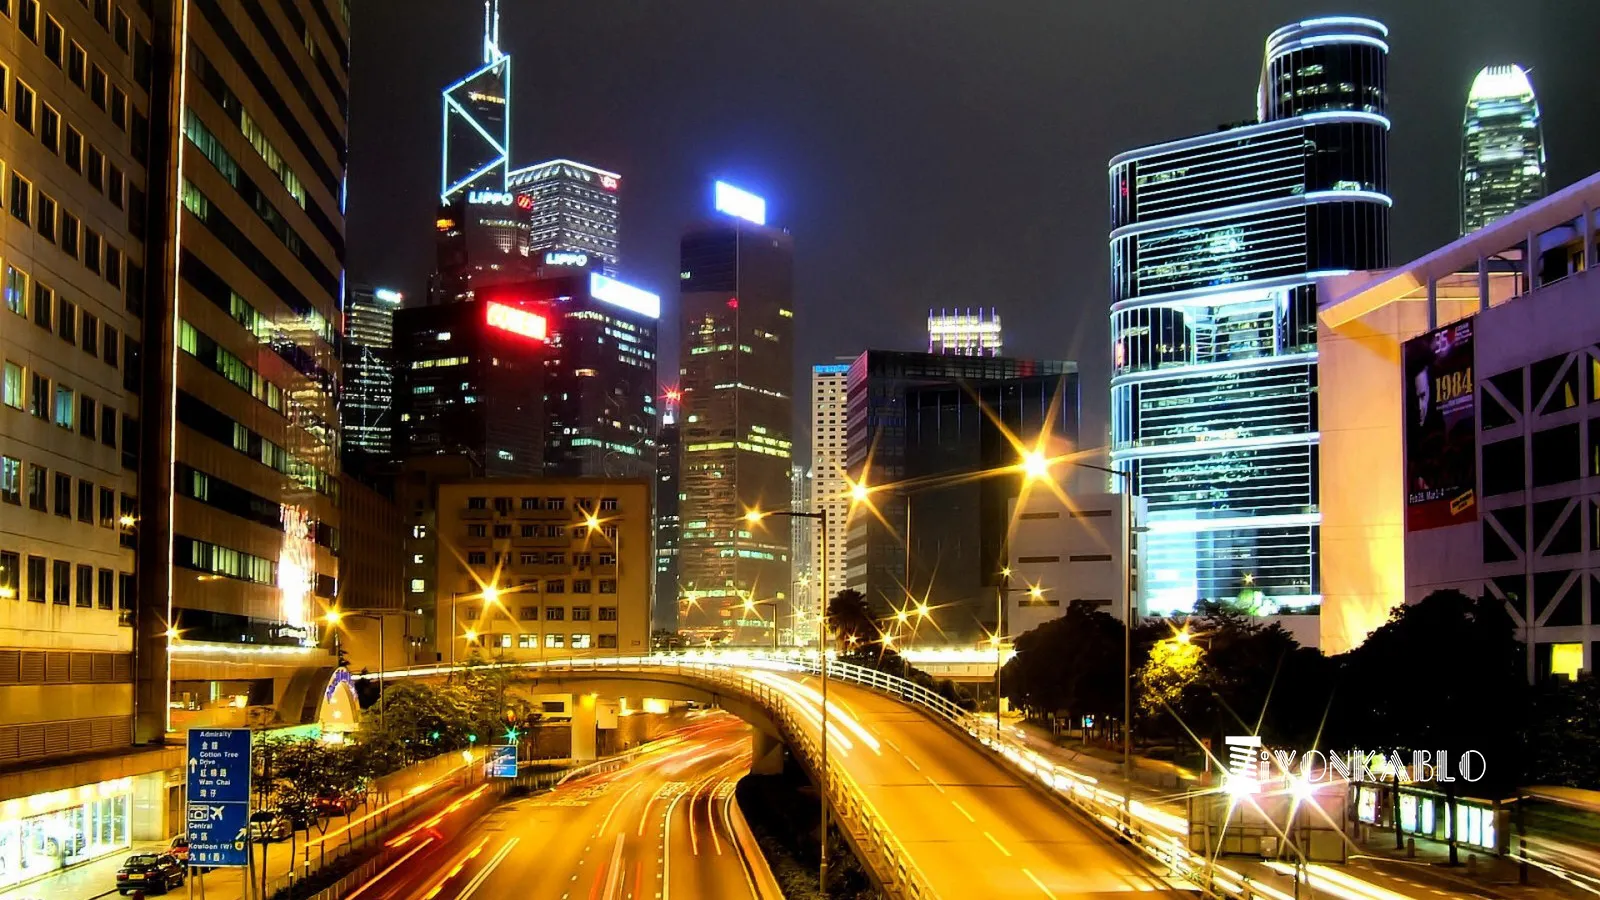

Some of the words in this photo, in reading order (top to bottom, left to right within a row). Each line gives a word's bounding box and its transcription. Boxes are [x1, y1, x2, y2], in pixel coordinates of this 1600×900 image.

[468, 191, 514, 206] LIPPO
[545, 252, 588, 267] LIPPO
[1435, 367, 1473, 403] 1984
